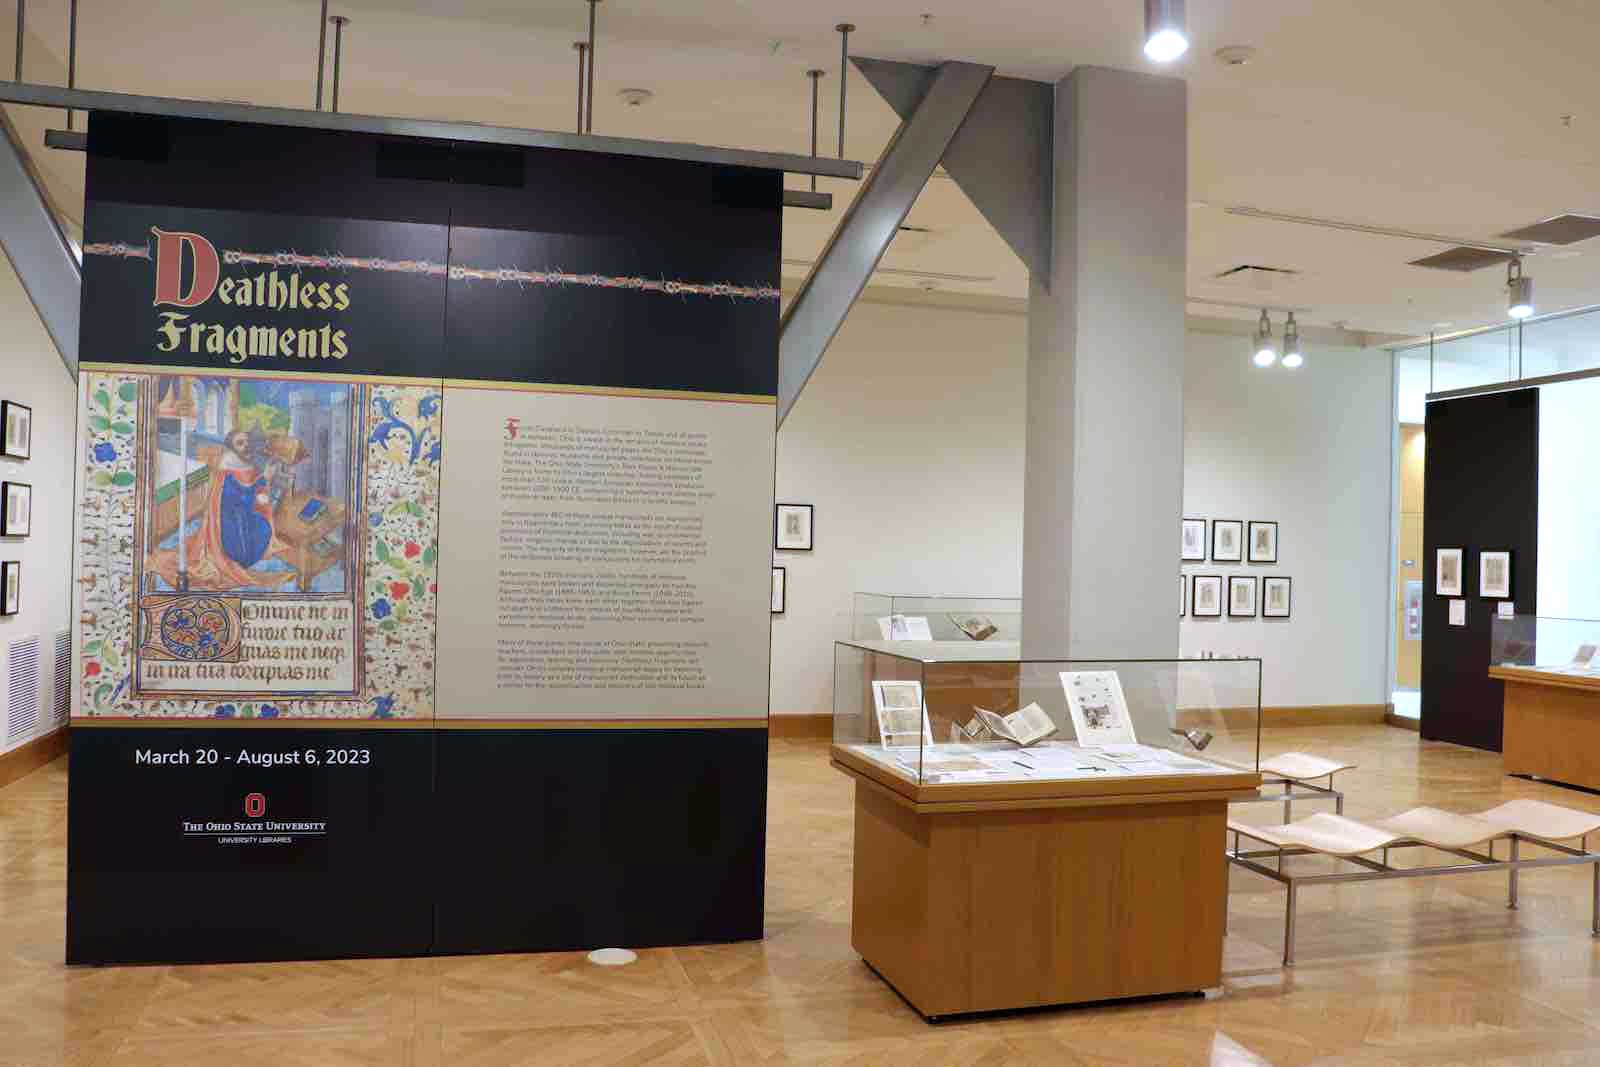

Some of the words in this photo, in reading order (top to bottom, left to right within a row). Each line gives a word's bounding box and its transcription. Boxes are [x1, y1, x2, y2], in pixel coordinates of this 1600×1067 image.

[150, 225, 351, 312] Deathless
[156, 311, 349, 364] Fragments
[135, 749, 190, 765] March
[196, 749, 218, 765] 20
[236, 749, 300, 768] August
[305, 749, 320, 767] 6,
[326, 749, 371, 765] 2023
[218, 836, 258, 844] UNIVERSITY
[259, 836, 292, 844] LIBRARIES
